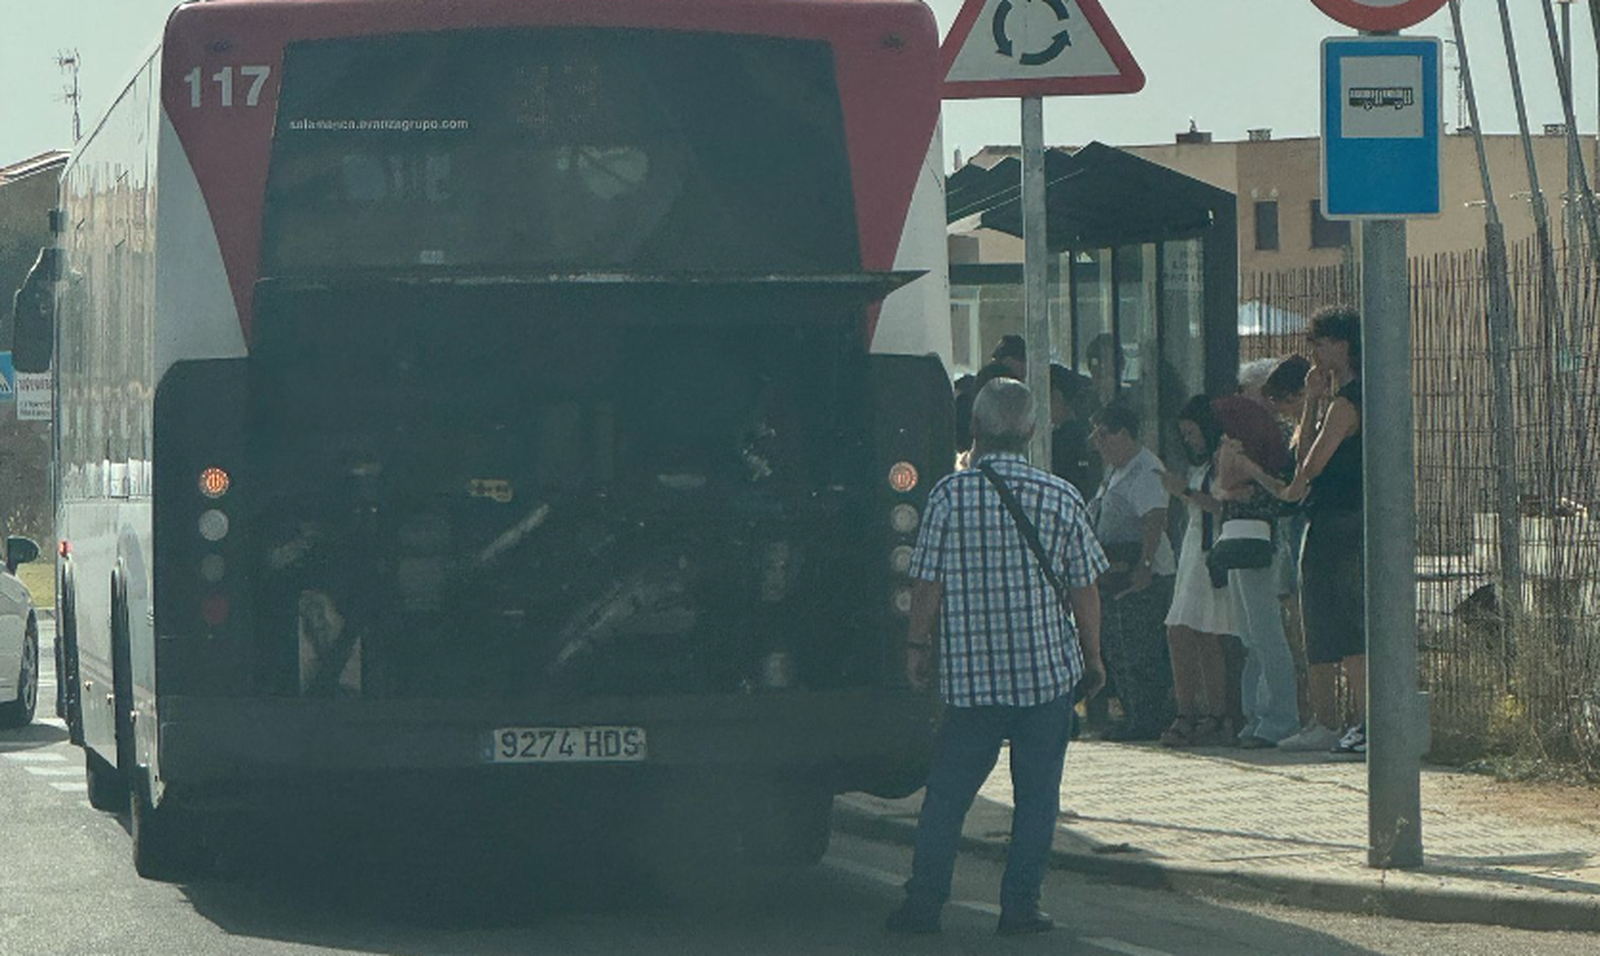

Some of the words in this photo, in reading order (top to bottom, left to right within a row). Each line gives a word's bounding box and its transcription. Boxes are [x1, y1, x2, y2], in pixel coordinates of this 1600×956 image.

[184, 65, 270, 108] 117
[501, 730, 574, 758] 9274
[585, 729, 640, 757] HDS
